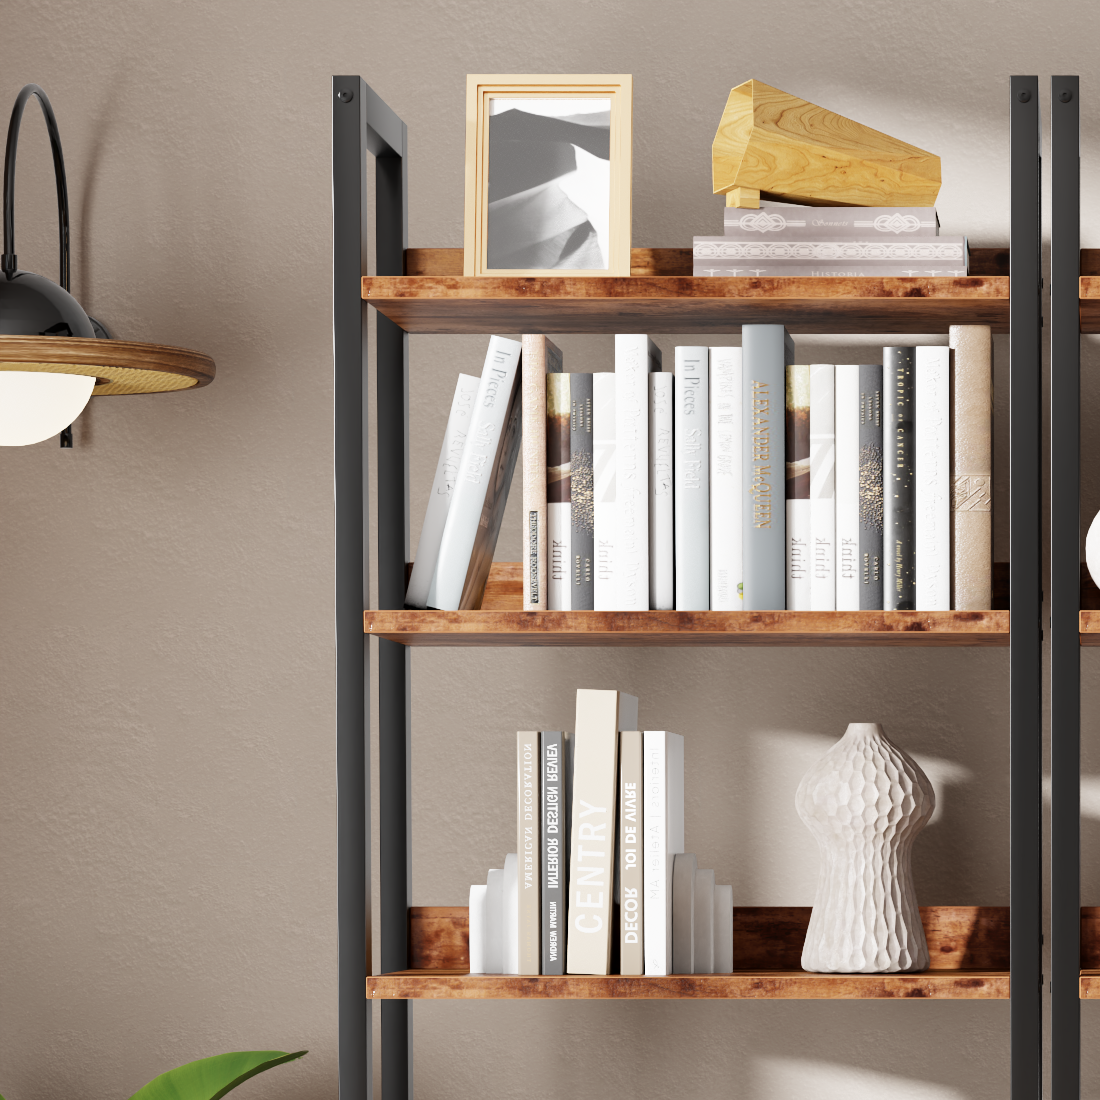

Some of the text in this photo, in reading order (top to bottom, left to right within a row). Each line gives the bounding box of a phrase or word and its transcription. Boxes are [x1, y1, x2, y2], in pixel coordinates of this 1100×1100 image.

[483, 350, 511, 408] In Pieces
[684, 359, 701, 415] In Pieces
[748, 380, 772, 529] ALEXANDER McQUEEN
[896, 428, 904, 468] CANCER
[574, 799, 607, 934] CENTRY
